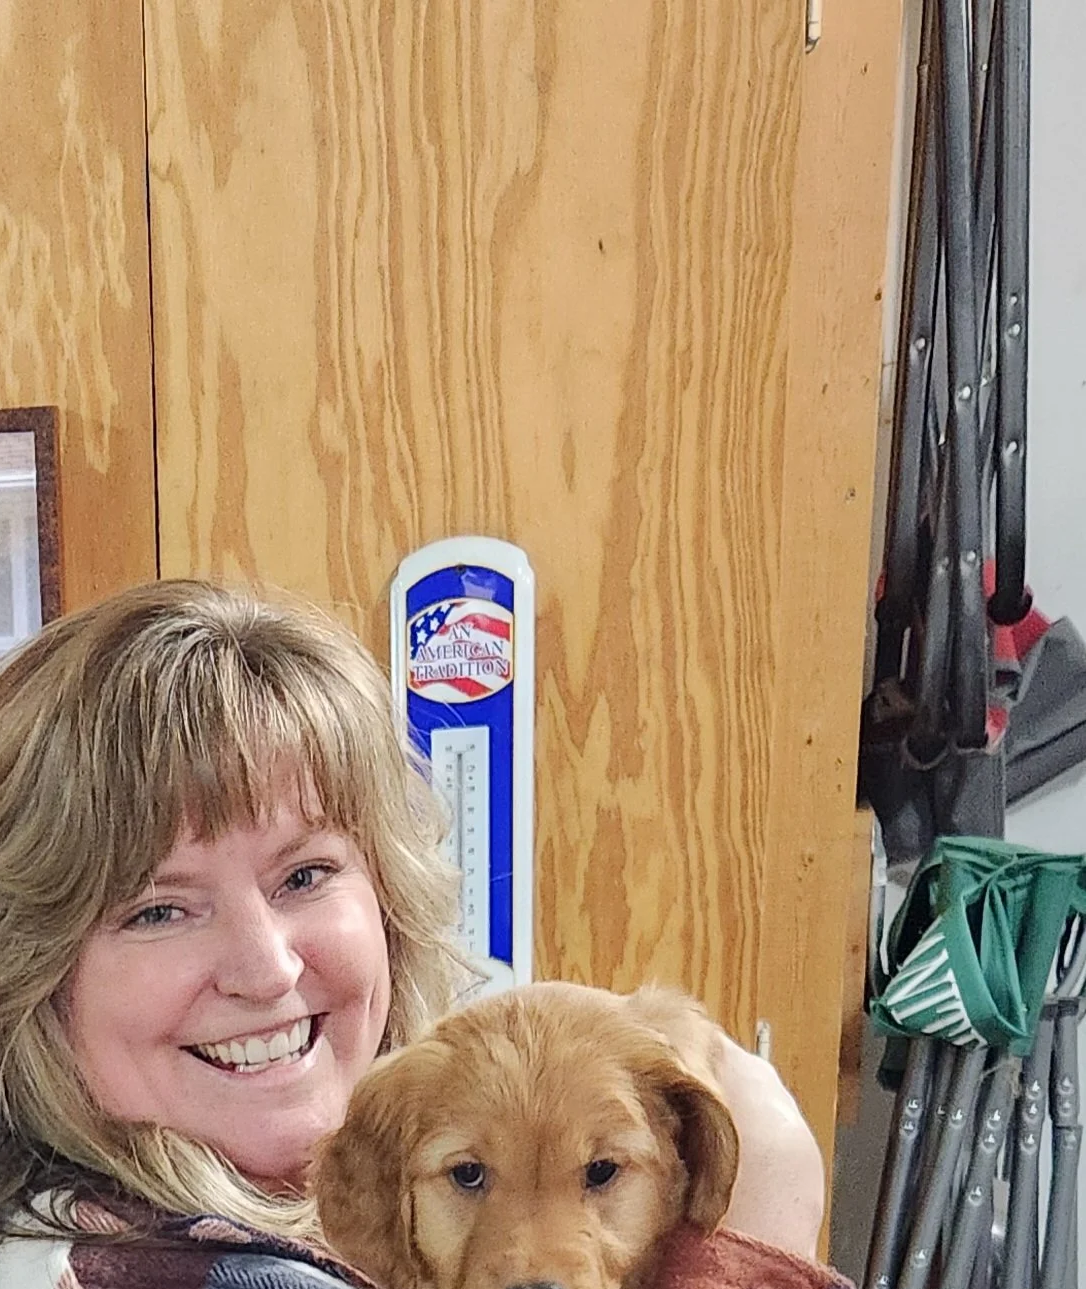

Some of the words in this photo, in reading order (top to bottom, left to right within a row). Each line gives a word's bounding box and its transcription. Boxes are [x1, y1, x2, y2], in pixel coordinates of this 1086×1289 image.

[448, 623, 471, 641] AN
[416, 640, 504, 663] AMERICAN
[414, 659, 509, 680] TRADITION
